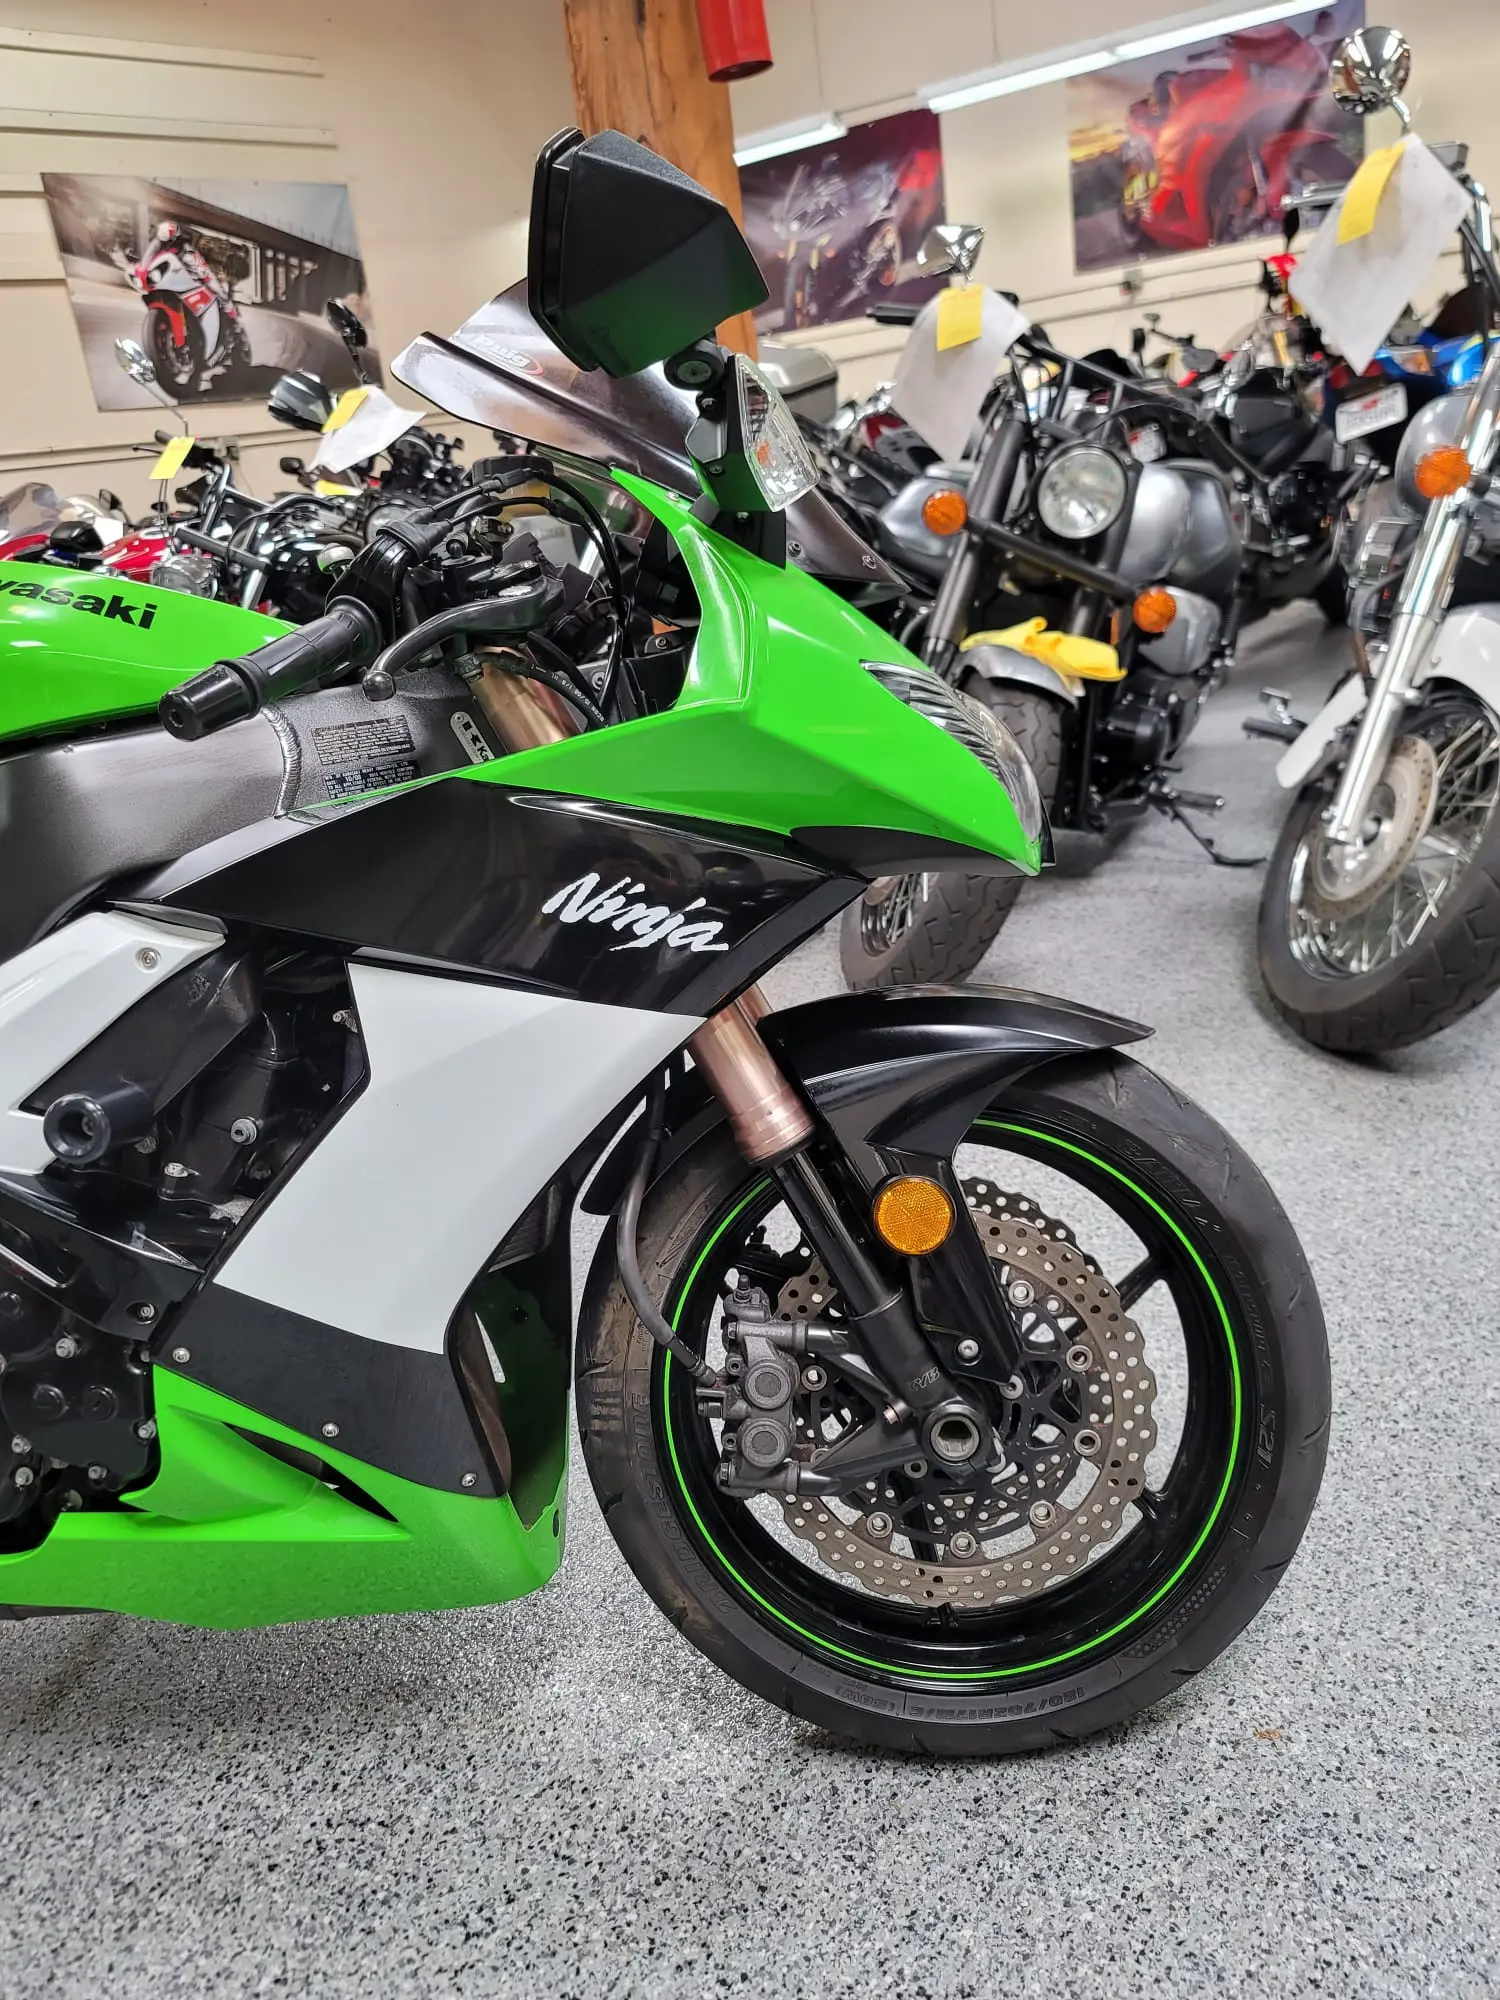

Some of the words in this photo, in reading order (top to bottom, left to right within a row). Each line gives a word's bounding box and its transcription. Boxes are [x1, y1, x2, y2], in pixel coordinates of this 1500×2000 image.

[471, 335, 532, 369] Puig
[541, 872, 729, 952] Ninja
[631, 1391, 738, 1615] BRIDGESTONE
